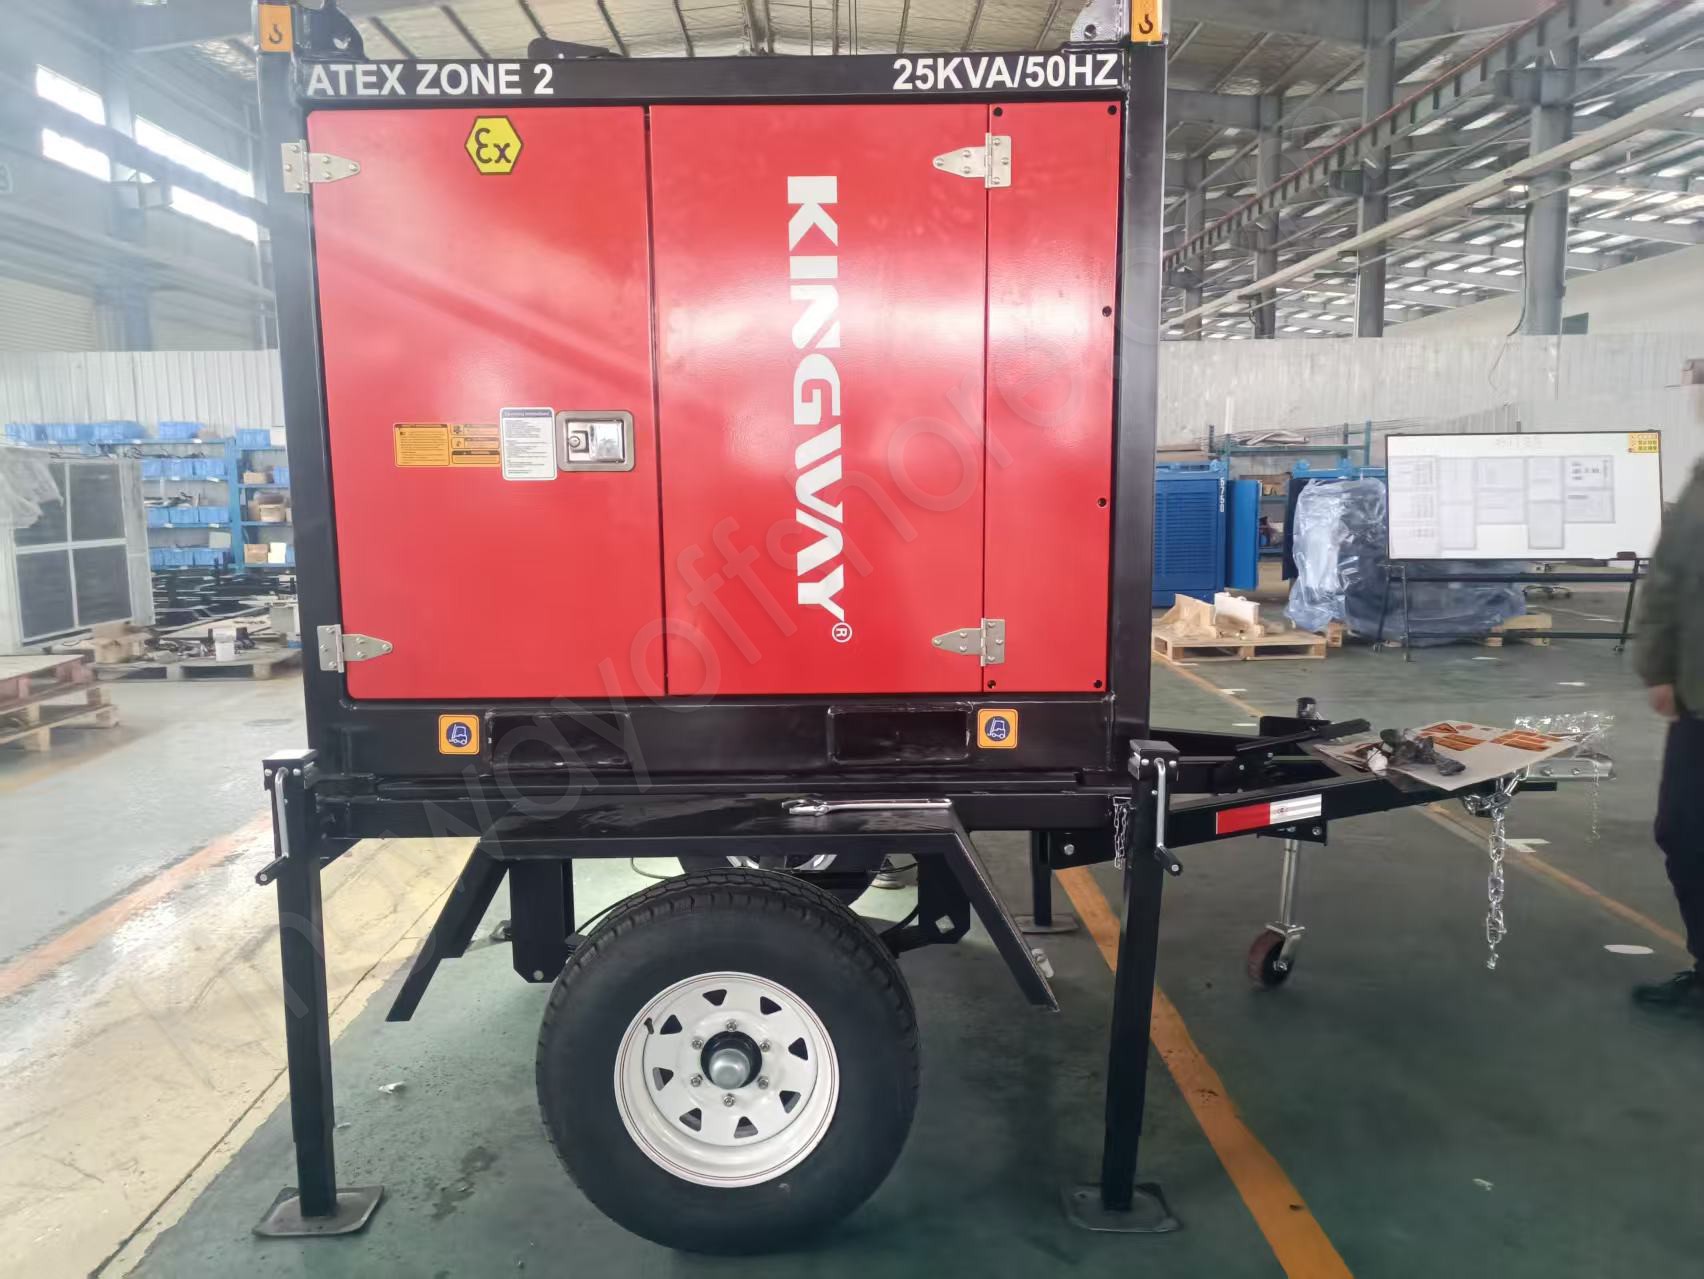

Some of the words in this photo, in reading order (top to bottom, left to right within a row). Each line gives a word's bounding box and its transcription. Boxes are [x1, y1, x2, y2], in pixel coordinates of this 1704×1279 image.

[306, 63, 406, 96] ATEX
[416, 63, 522, 95] ZONE
[533, 63, 554, 95] 2
[892, 54, 1118, 90] 25KVA/50HZ
